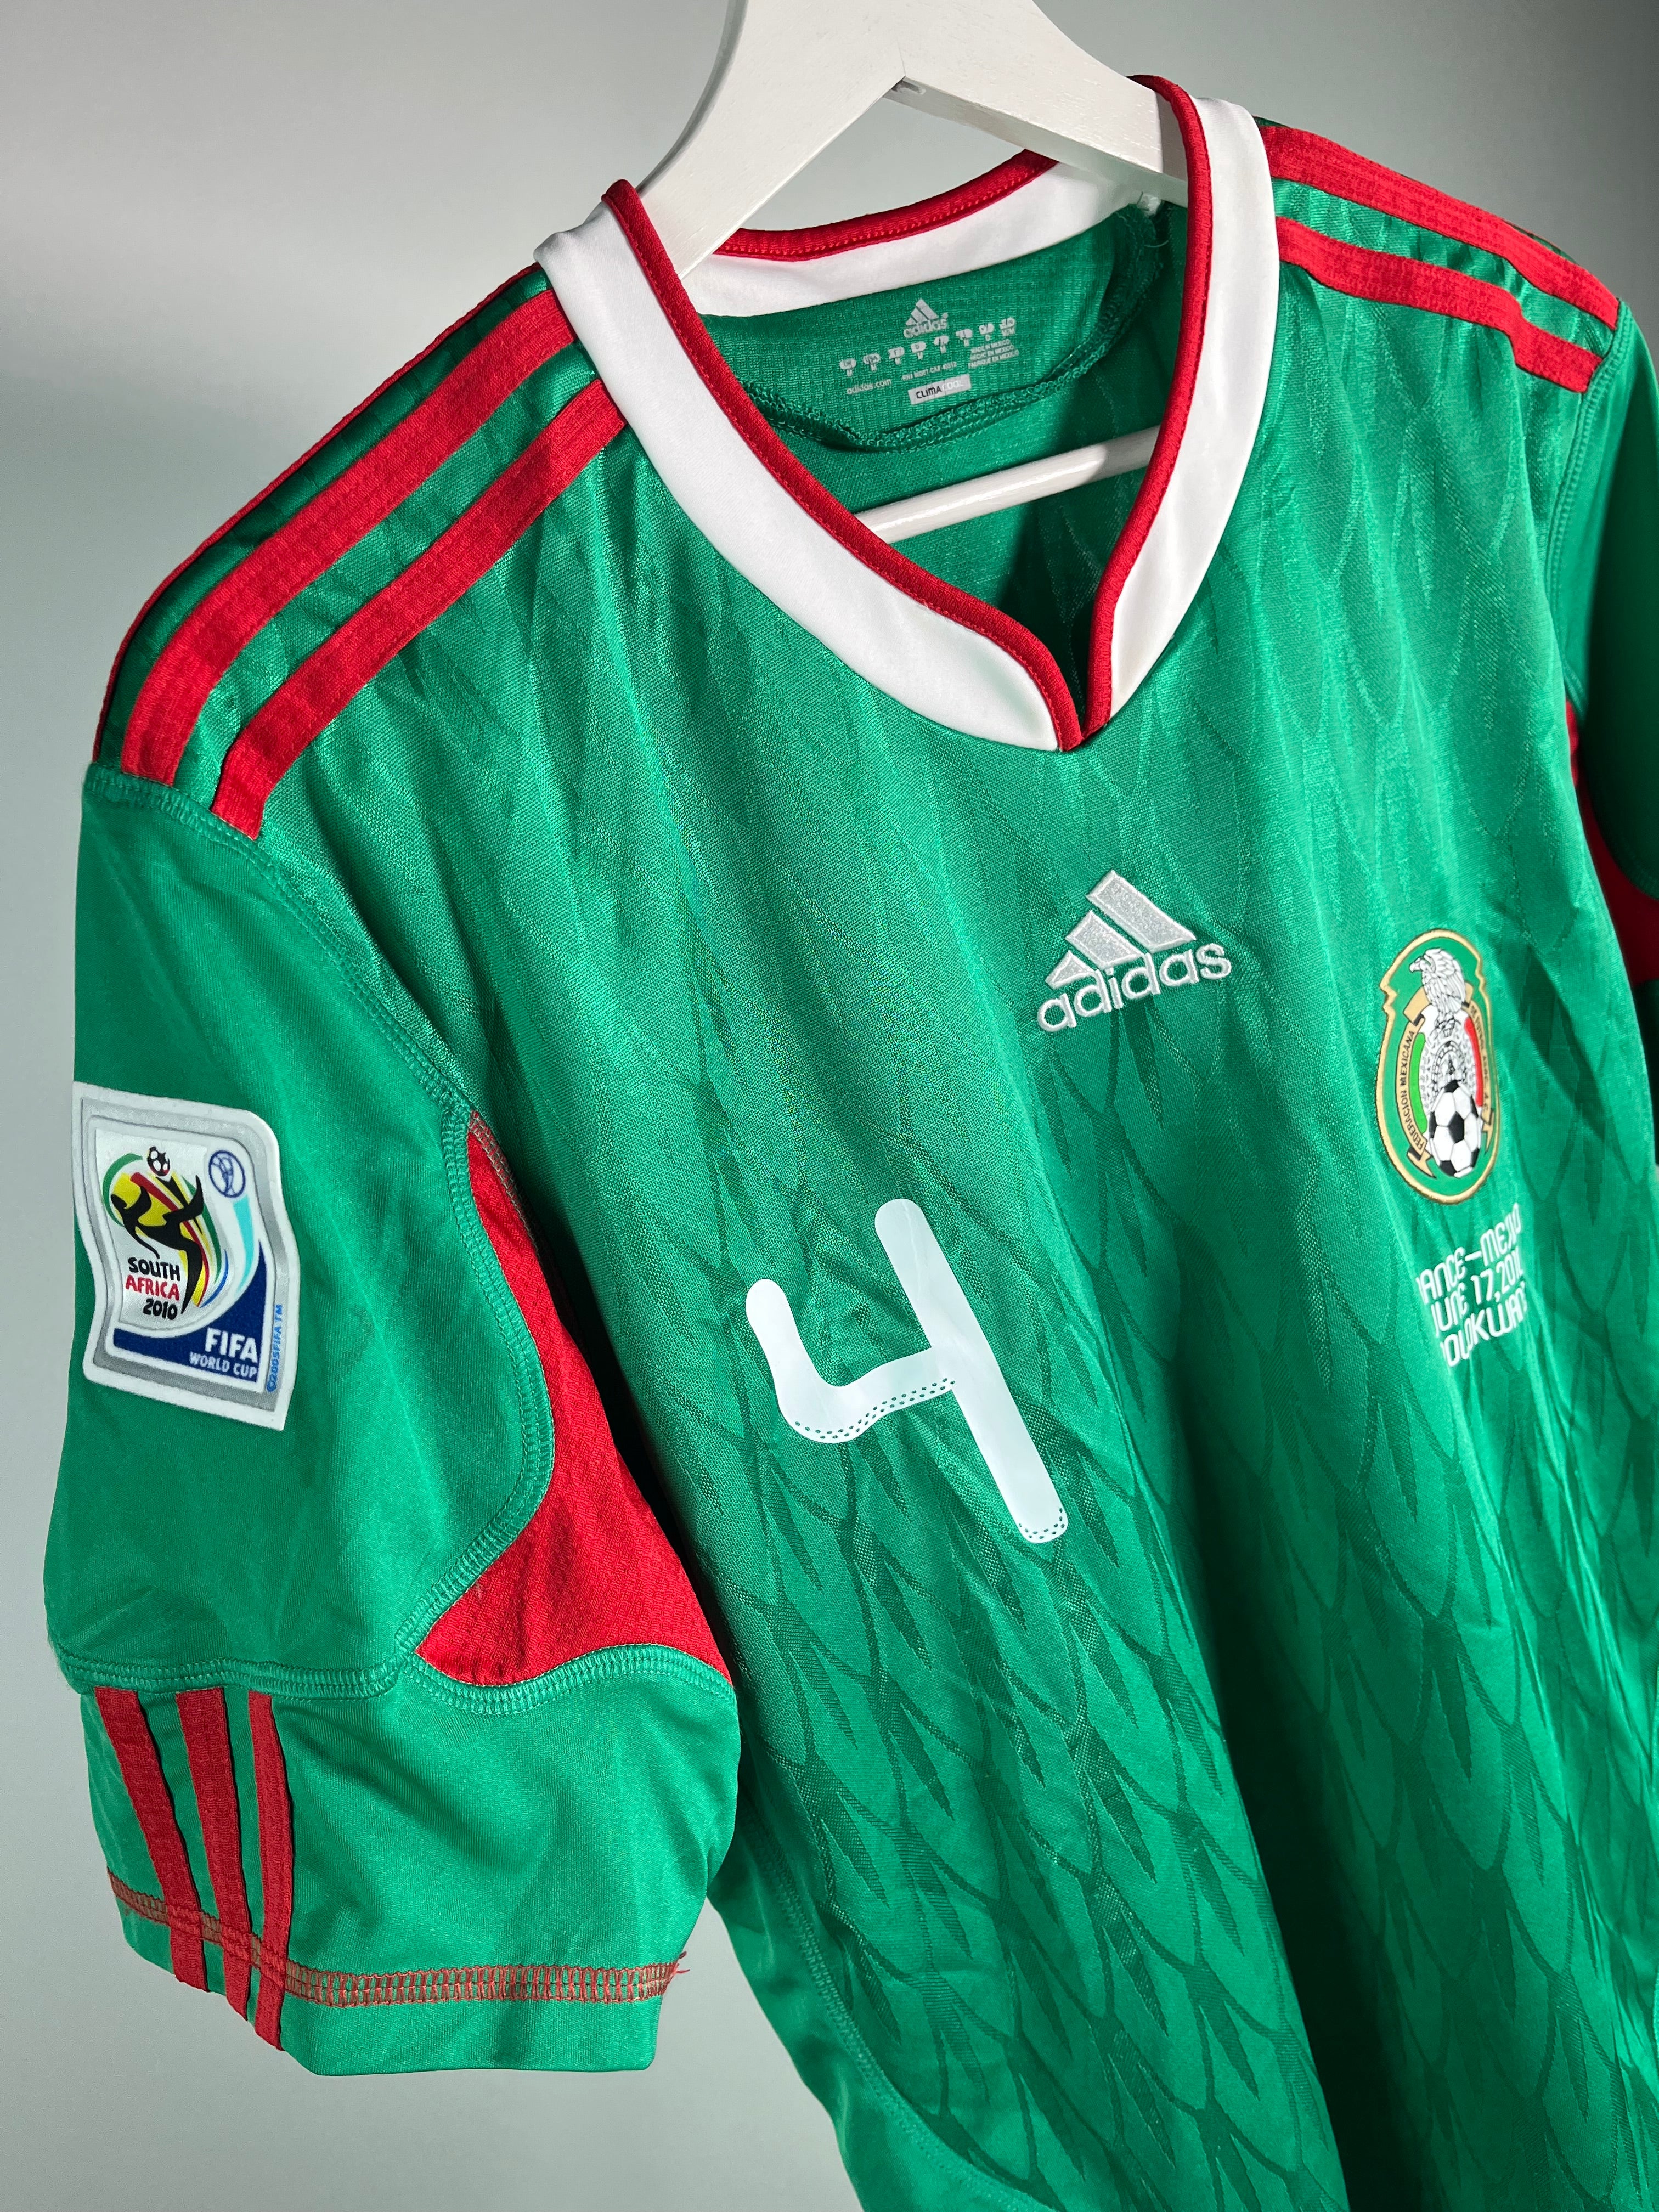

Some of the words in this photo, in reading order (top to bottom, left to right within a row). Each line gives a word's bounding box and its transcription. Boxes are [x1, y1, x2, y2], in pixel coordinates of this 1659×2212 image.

[904, 318, 948, 338] adidas
[1037, 943, 1232, 1032] adidas
[1400, 1031, 1415, 1087] MEXICANA
[1400, 1090, 1425, 1150] FEDERACION
[127, 1257, 180, 1282] SOUTH
[126, 1274, 180, 1302] AFRICA
[143, 1298, 178, 1321] 2010
[205, 1327, 258, 1363] FIFA
[189, 1351, 230, 1373] WORLD
[233, 1363, 257, 1378] CUP
[746, 1198, 1069, 1543] 4
